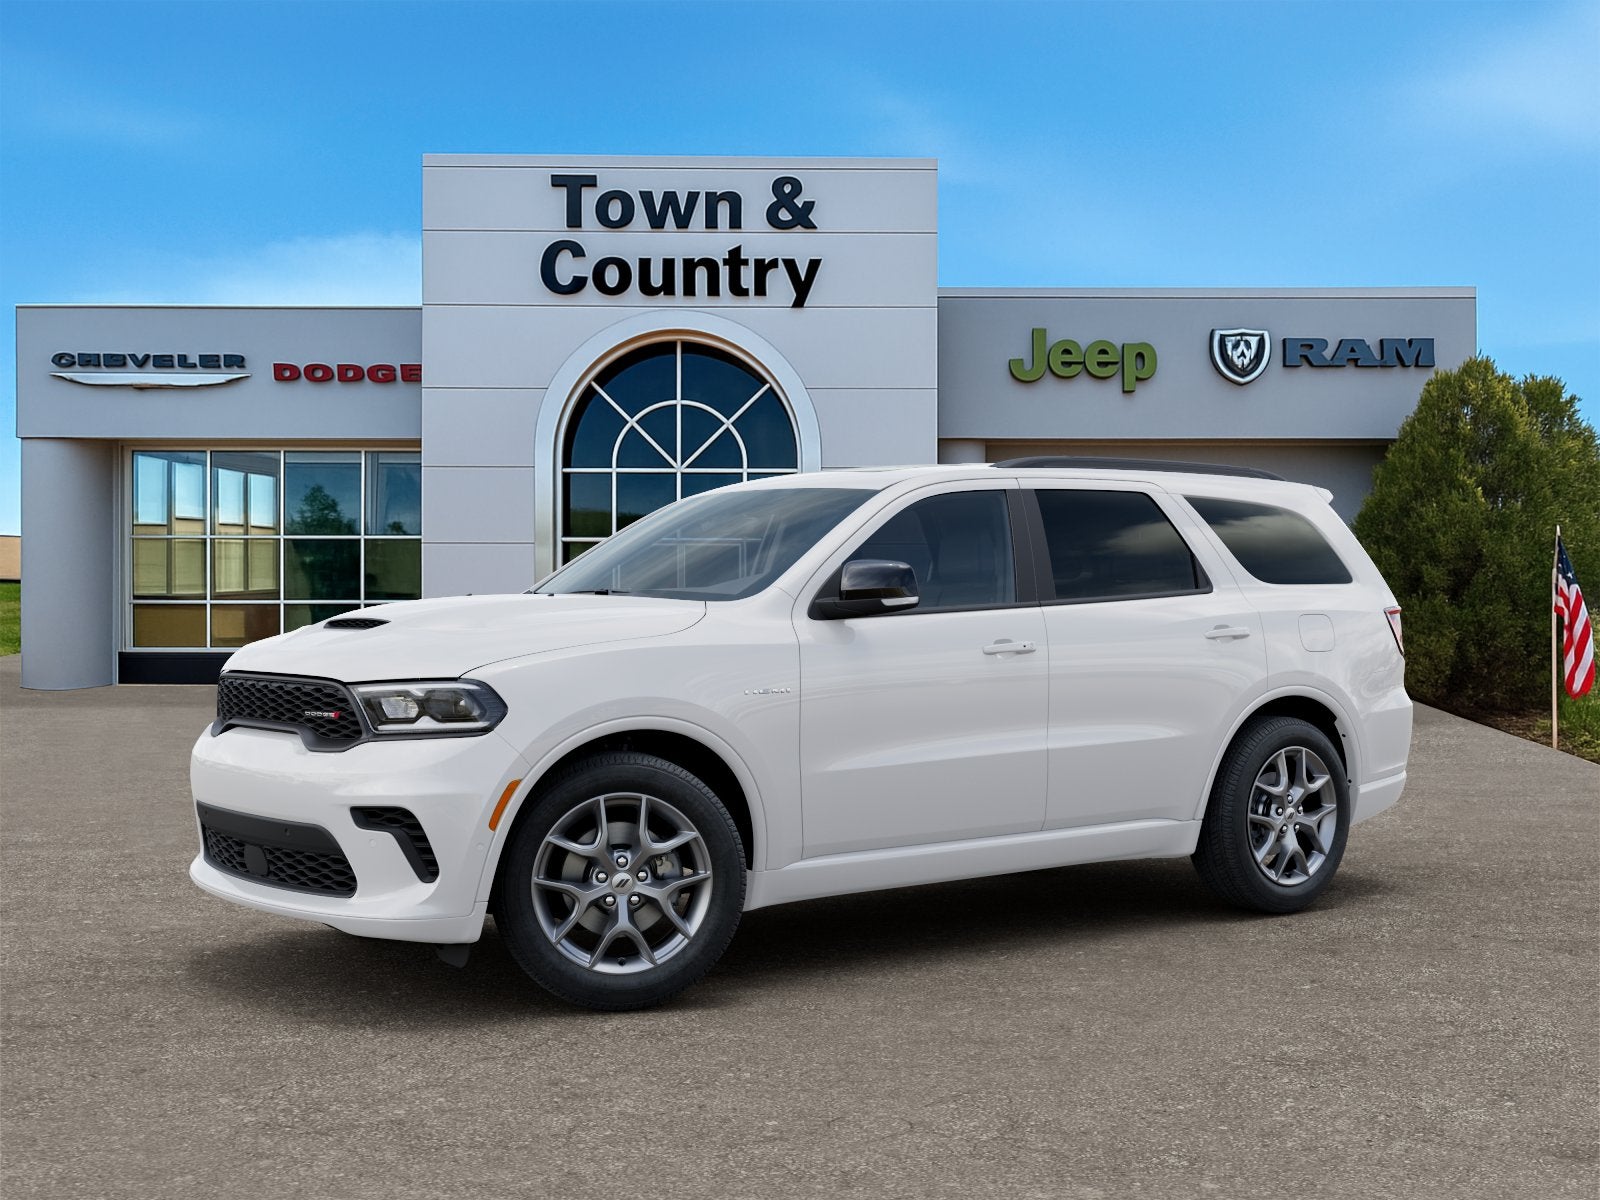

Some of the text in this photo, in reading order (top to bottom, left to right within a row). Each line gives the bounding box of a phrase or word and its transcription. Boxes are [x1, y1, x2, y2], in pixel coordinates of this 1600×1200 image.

[550, 174, 818, 230] Town &
[540, 239, 822, 308] Country
[272, 362, 422, 383] DODGE
[1008, 327, 1158, 393] Jeep
[1282, 337, 1435, 368] RAM
